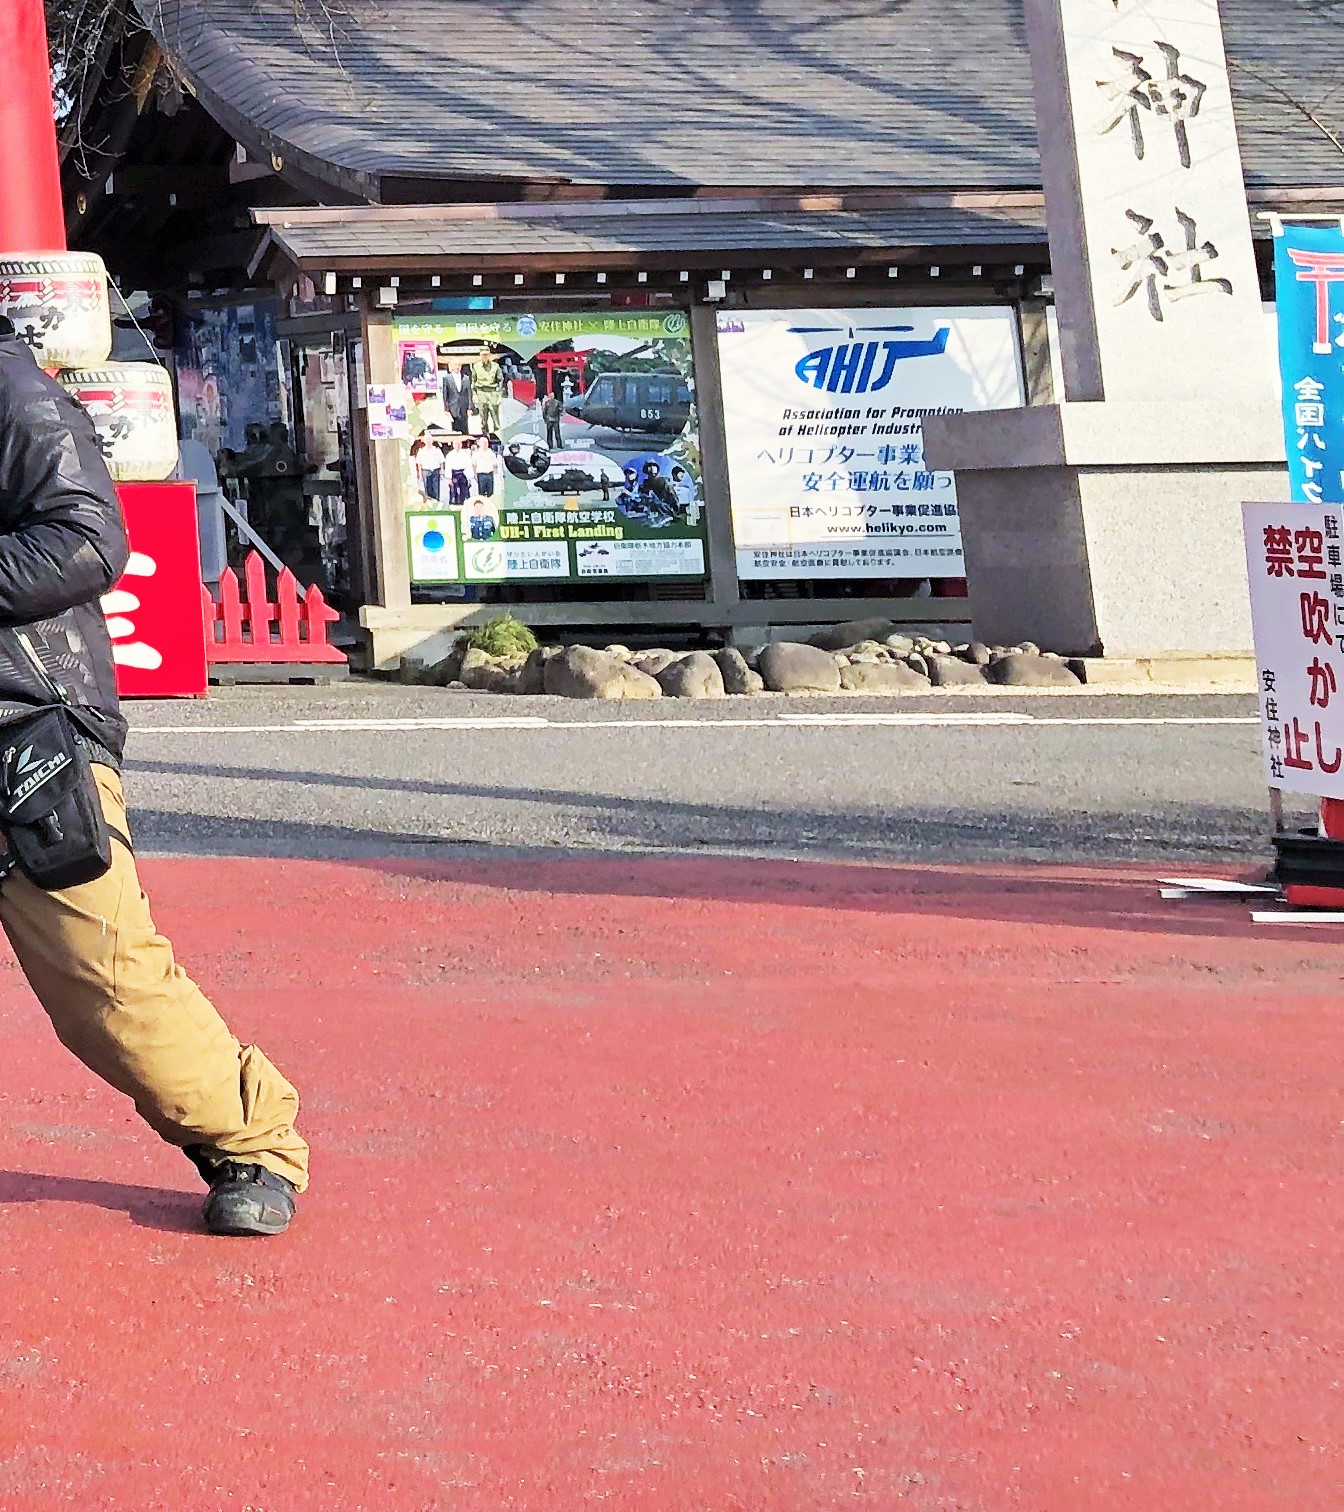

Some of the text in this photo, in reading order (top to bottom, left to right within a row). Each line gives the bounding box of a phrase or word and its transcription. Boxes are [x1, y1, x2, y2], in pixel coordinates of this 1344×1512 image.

[539, 320, 582, 333] 安住神社
[604, 319, 660, 332] 陸上自衛隊
[640, 407, 661, 420] 853
[782, 408, 861, 420] Association
[865, 408, 886, 419] for
[778, 424, 794, 436] of
[797, 423, 868, 437] Helicopter
[757, 443, 926, 465] ヘリコプター事業
[533, 525, 564, 538] First
[568, 525, 624, 539] Landing
[827, 522, 947, 534] www.helikyo.com
[507, 559, 562, 570] 陸上自衛隊
[1294, 526, 1342, 774] 空吹かし
[1262, 669, 1285, 779] 安住神社
[12, 752, 66, 798] TAICHI
